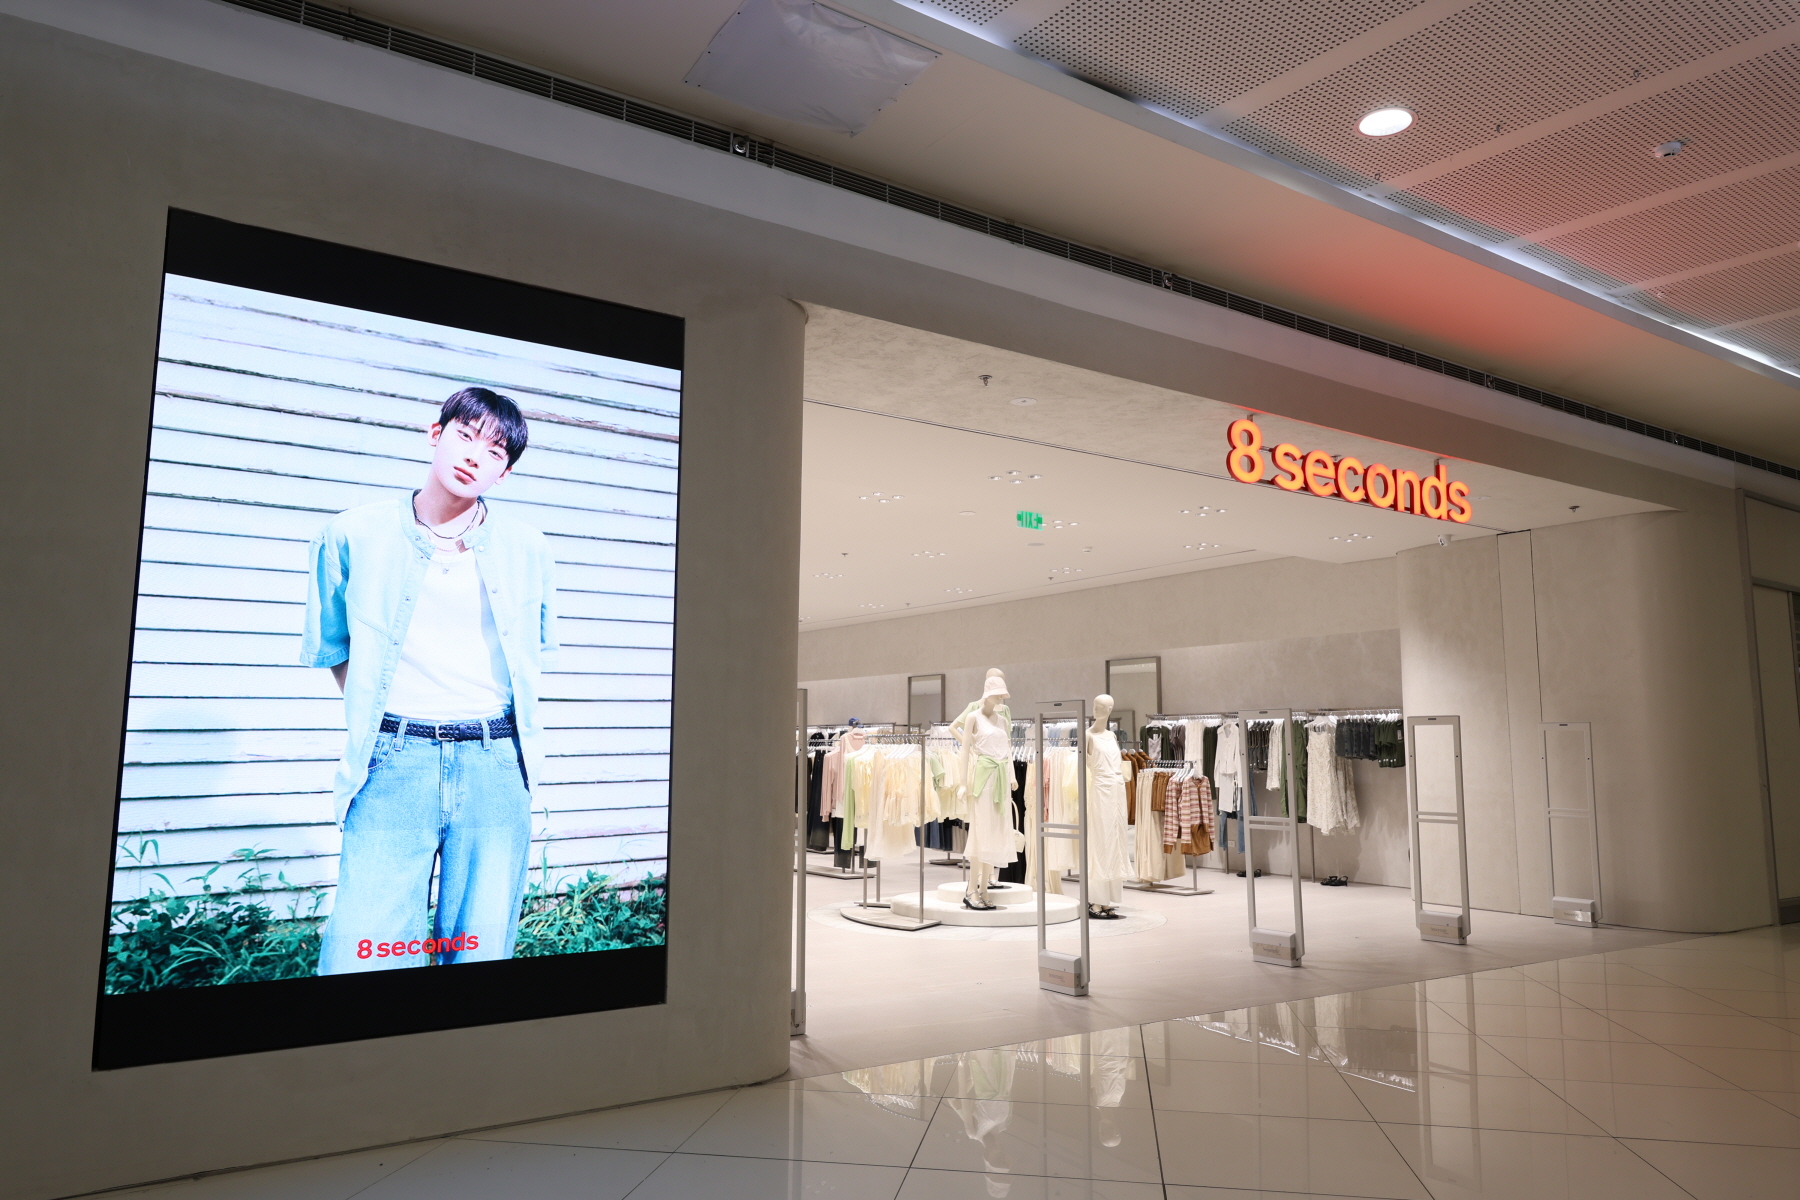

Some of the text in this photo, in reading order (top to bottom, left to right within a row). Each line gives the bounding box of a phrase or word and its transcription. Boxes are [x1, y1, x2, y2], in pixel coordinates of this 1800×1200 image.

[1226, 418, 1473, 524] 8 seconds
[356, 931, 479, 960] 8 seconds
